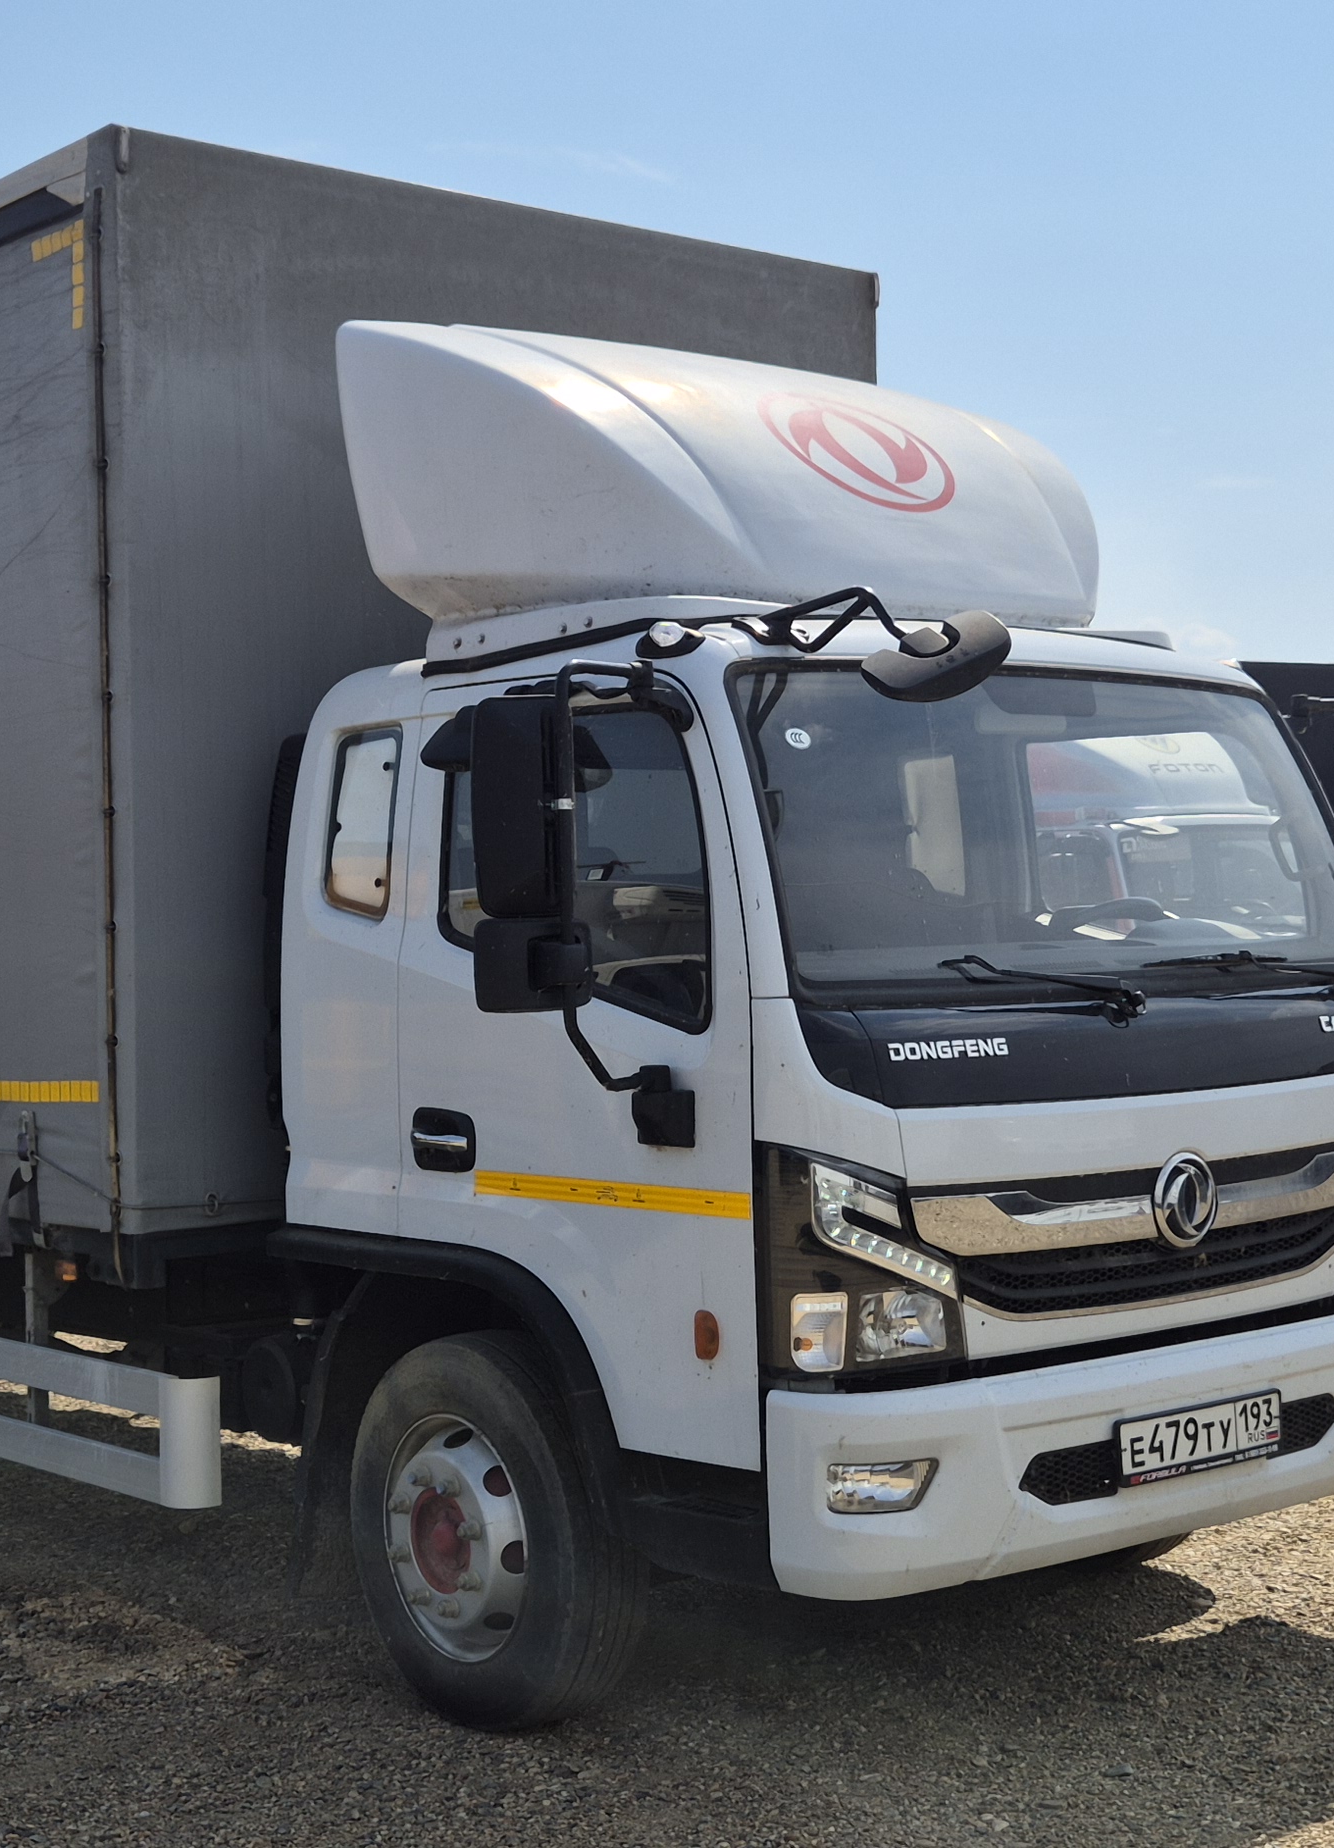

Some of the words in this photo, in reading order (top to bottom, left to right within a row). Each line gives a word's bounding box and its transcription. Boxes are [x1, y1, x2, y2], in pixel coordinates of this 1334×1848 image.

[887, 1037, 1009, 1061] DONGFENG
[1130, 1417, 1232, 1469] Е479ТУ
[1238, 1398, 1273, 1432] 193
[1247, 1431, 1266, 1444] RUS
